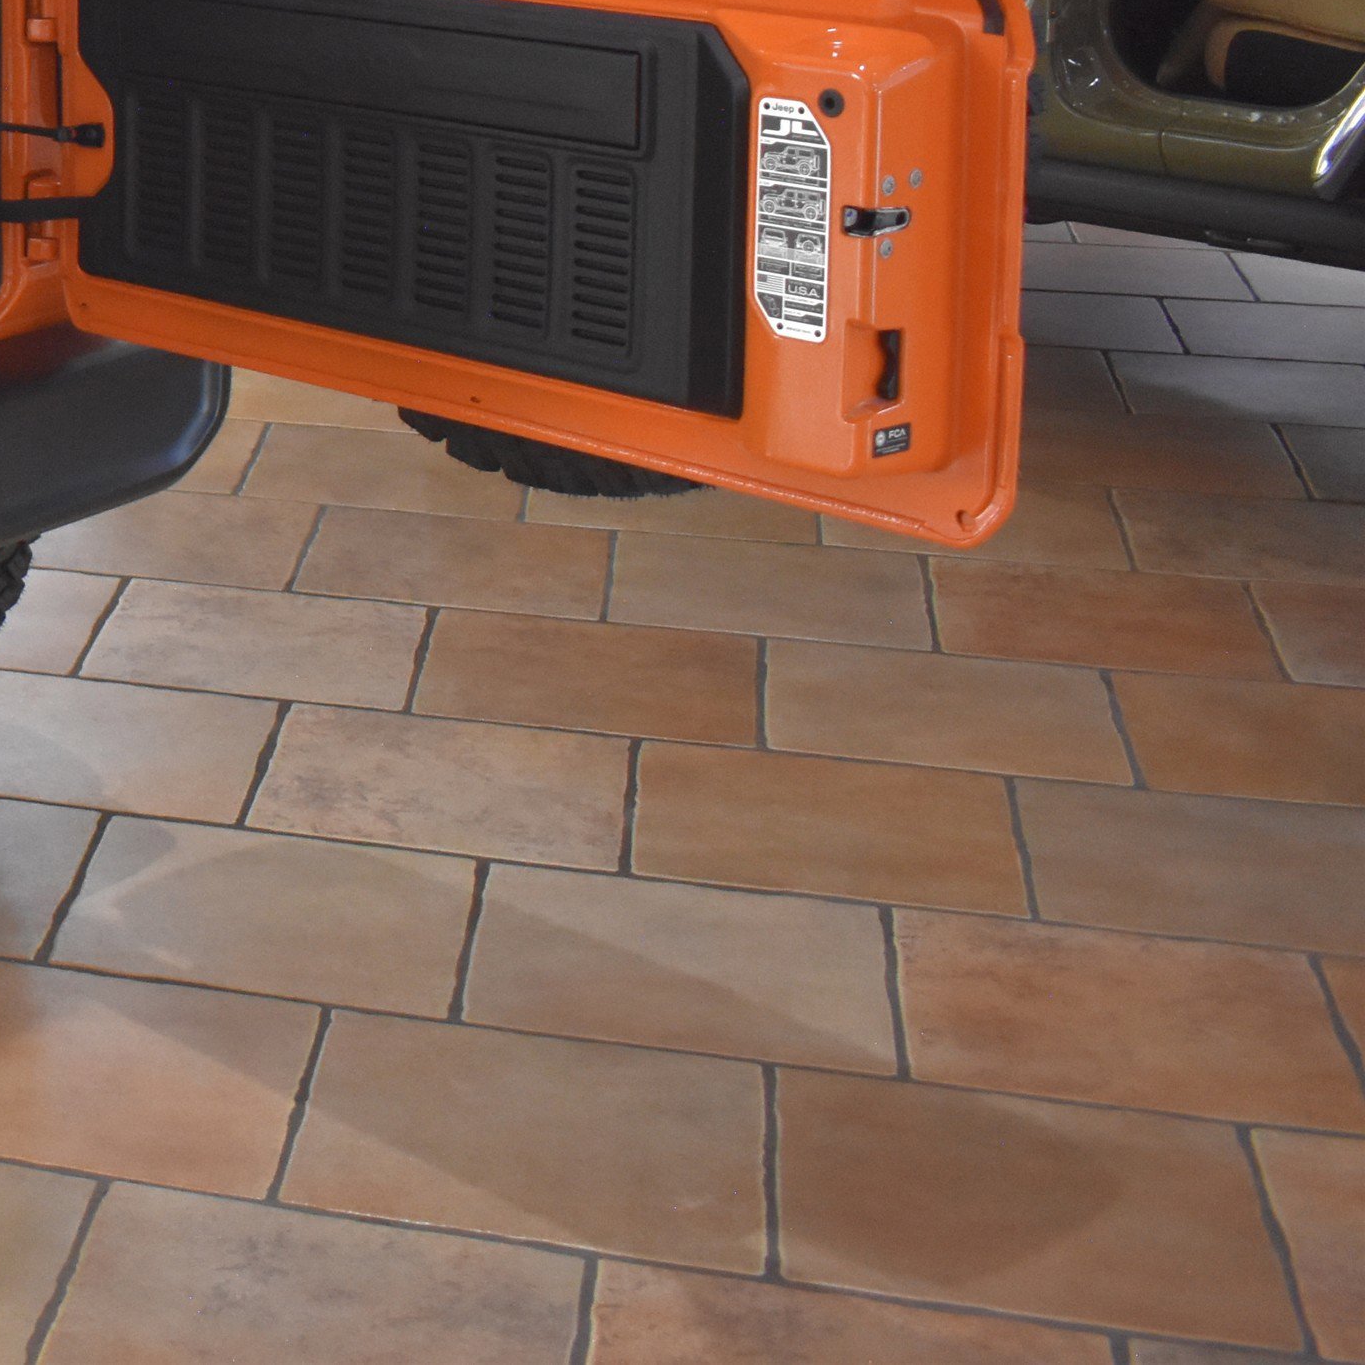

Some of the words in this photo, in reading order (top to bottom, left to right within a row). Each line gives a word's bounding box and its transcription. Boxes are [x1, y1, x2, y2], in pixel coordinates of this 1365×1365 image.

[772, 103, 795, 114] Jeep
[762, 118, 820, 137] JL
[888, 428, 906, 439] FCA
